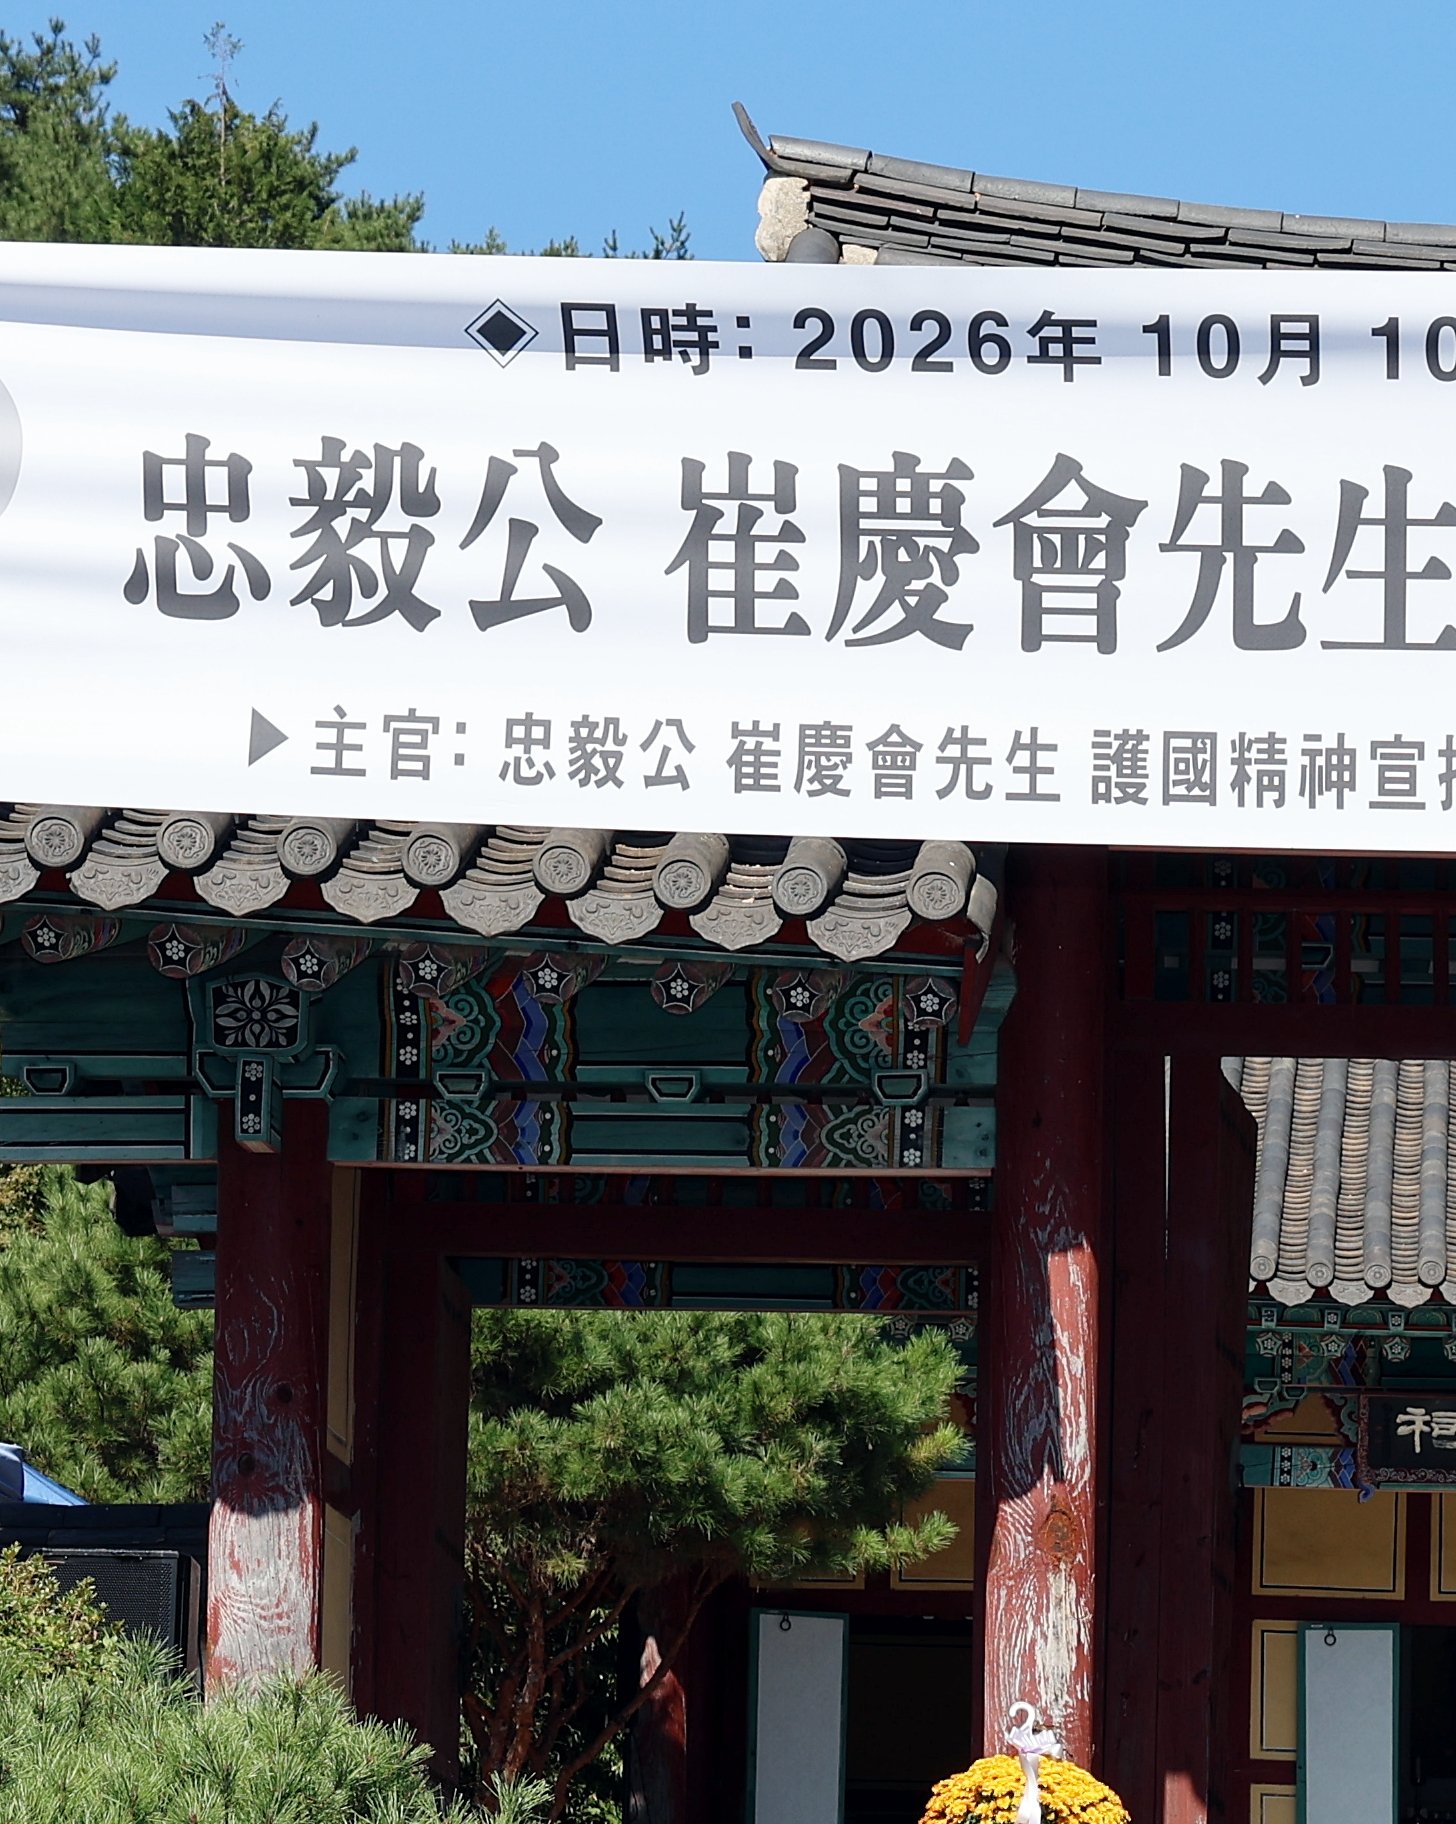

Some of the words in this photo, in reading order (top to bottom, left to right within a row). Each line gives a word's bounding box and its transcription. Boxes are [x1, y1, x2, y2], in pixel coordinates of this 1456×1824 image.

[560, 302, 753, 376] 日時:
[793, 307, 1102, 382] 2026年
[1142, 314, 1320, 386] 10月
[123, 433, 603, 633] 忠毅公
[311, 705, 466, 780] 主官:
[499, 712, 695, 791] 忠毅公
[727, 720, 1060, 802] 崔慶會先生
